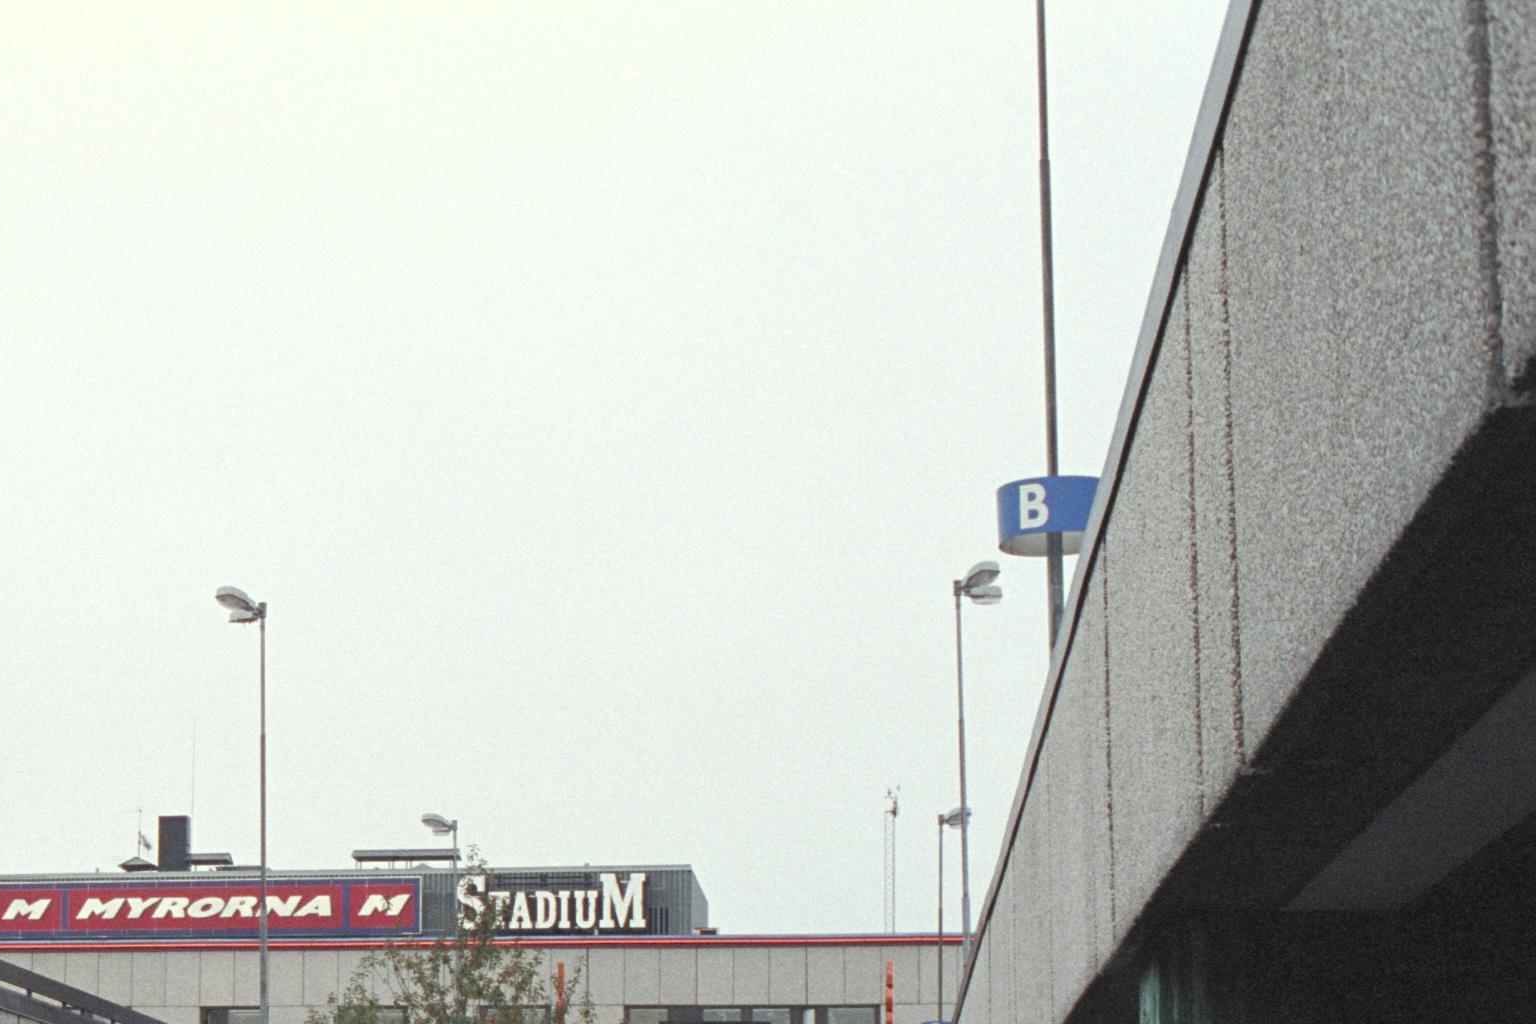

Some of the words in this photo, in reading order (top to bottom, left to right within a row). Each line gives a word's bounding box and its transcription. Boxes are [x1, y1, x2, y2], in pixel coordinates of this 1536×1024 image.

[1019, 483, 1049, 530] B
[2, 898, 52, 920] M
[75, 895, 333, 920] MYRORNA
[358, 893, 411, 916] M
